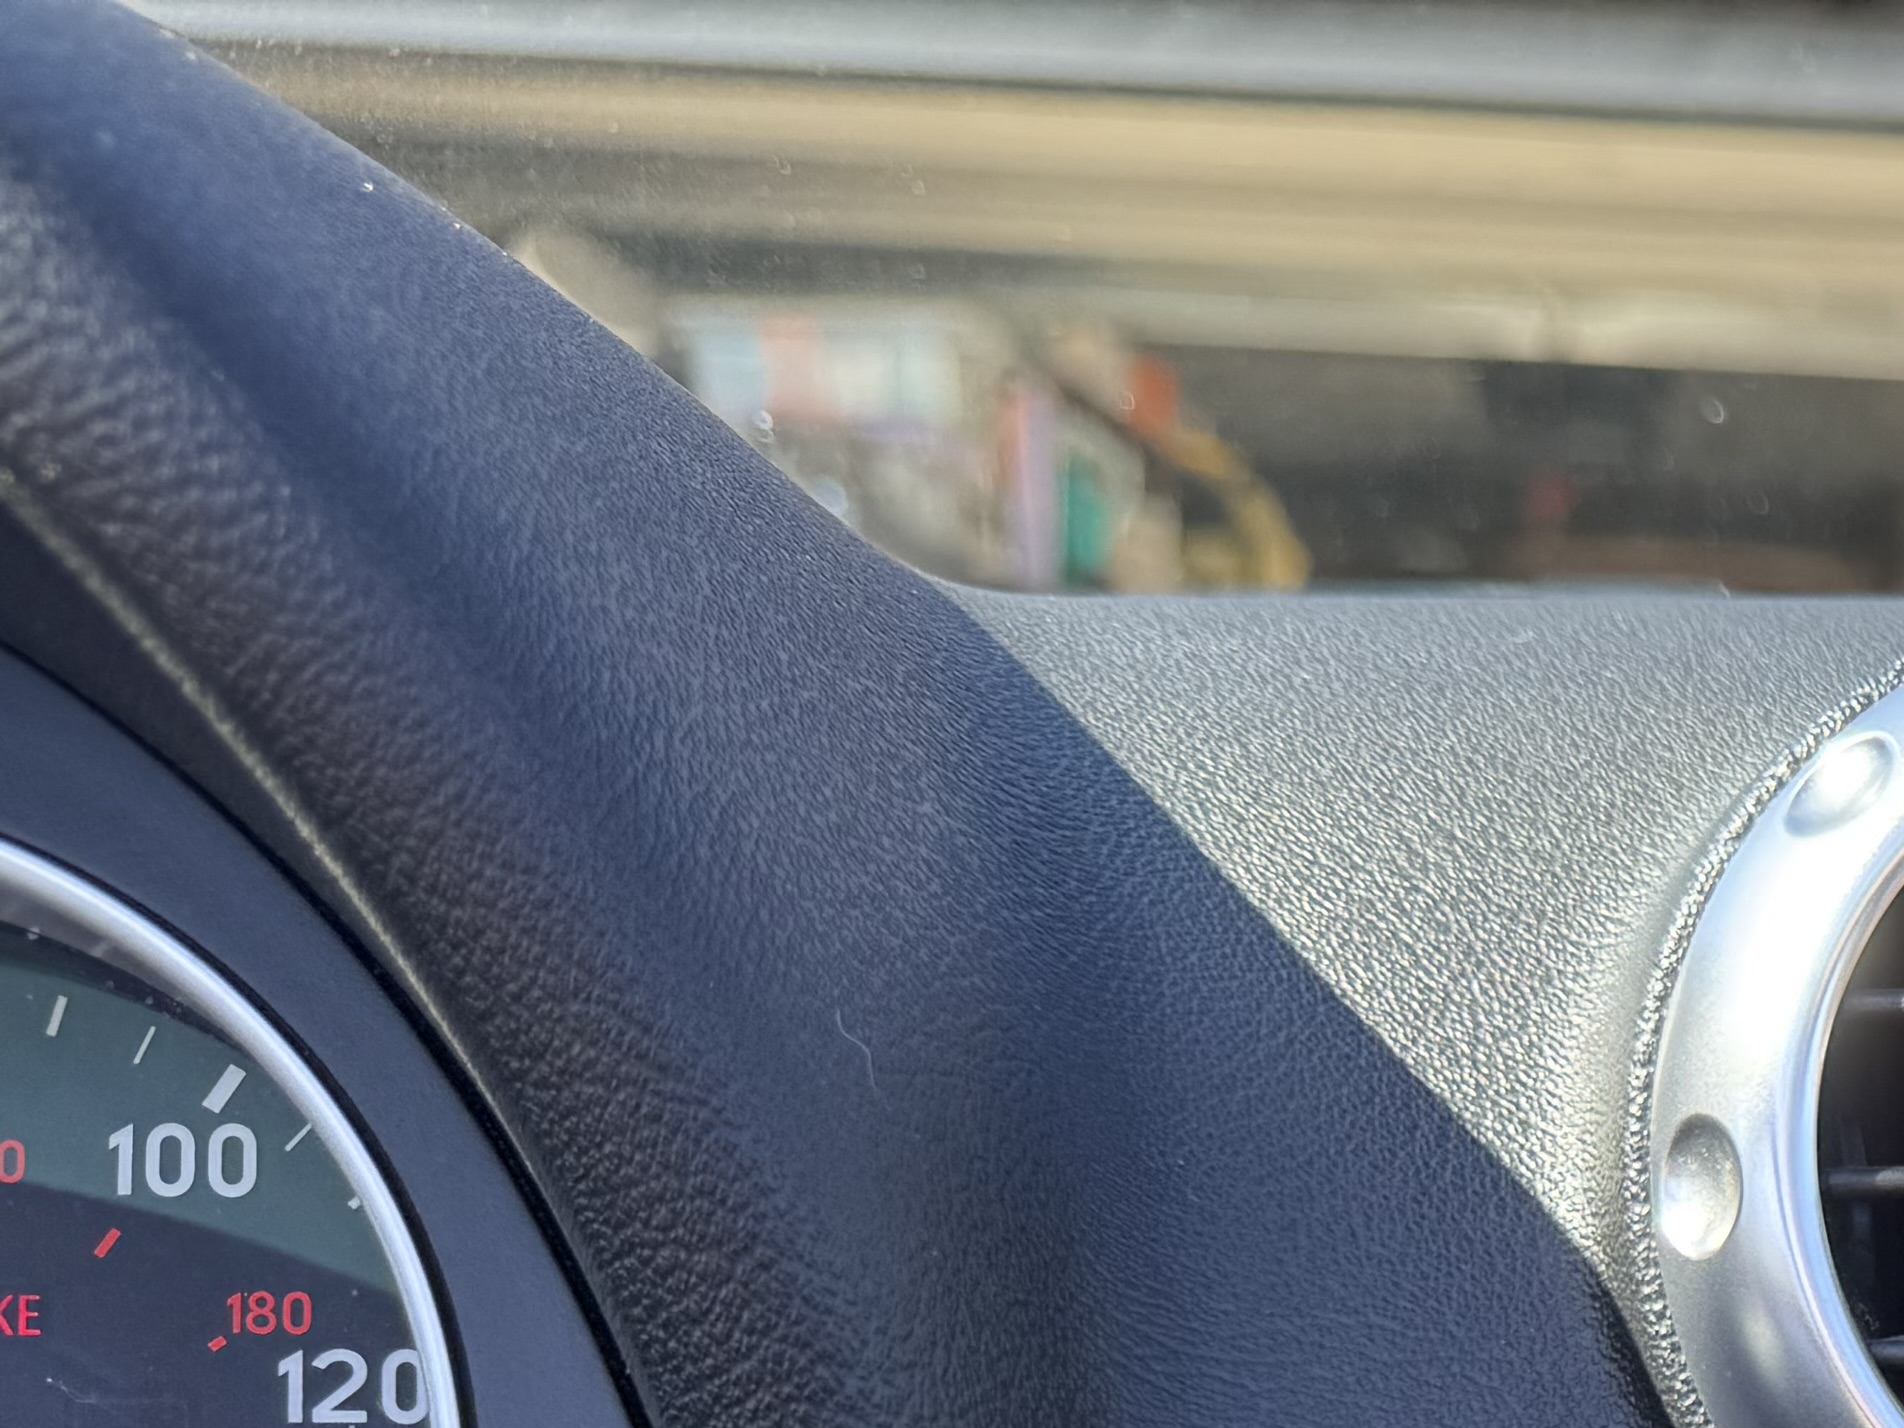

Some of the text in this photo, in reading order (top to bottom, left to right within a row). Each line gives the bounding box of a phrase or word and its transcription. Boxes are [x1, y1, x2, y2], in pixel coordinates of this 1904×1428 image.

[108, 1122, 257, 1198] 100
[227, 1290, 313, 1335] 180
[277, 1348, 431, 1425] 120
